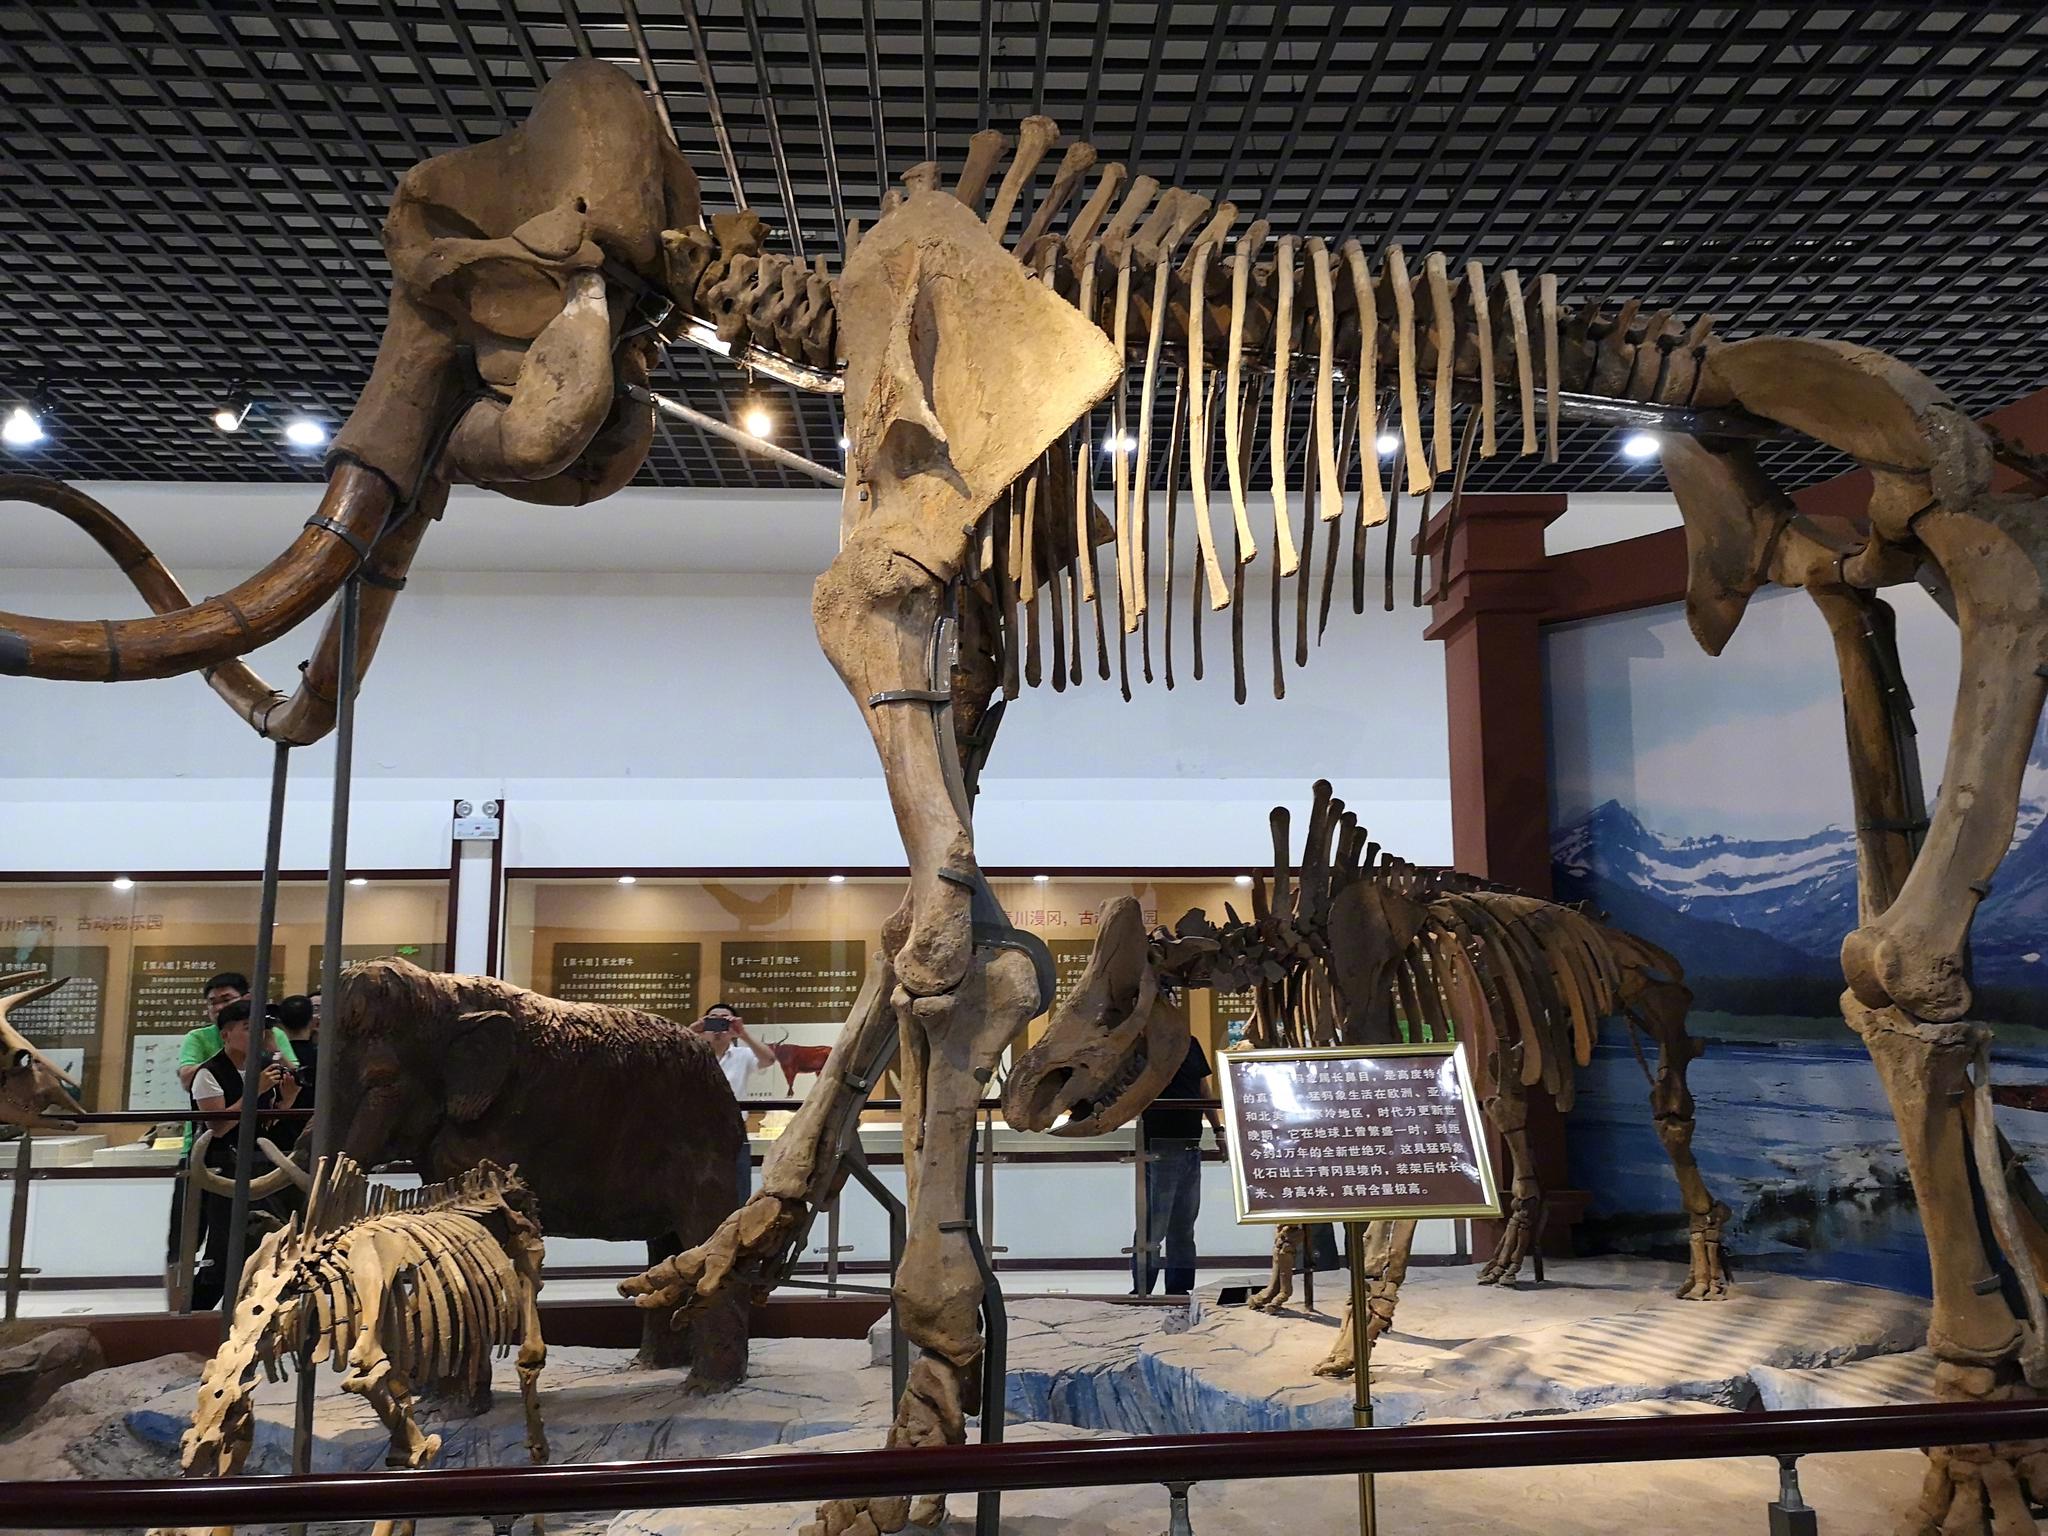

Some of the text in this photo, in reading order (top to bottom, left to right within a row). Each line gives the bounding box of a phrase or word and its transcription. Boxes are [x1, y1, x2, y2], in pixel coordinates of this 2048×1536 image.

[1255, 1183, 1428, 1199] 米、身高4米，真骨含量极高。
